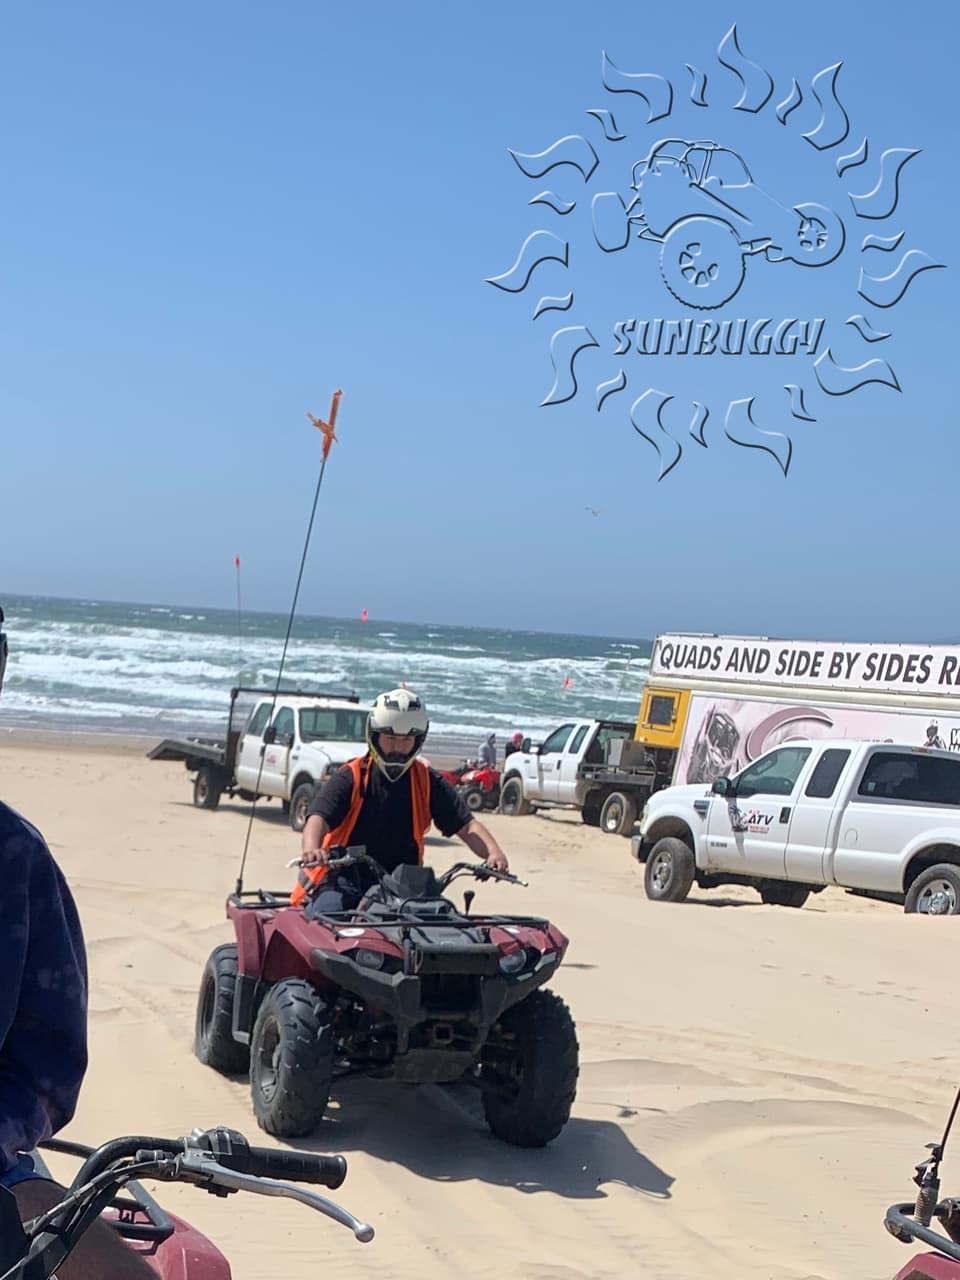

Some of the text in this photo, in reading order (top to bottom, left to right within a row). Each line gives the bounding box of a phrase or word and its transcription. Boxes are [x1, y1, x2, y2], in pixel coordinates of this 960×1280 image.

[659, 642, 723, 671] QUADS
[725, 646, 771, 675] AND
[775, 648, 825, 678] SIDE
[827, 650, 861, 680] BY
[862, 652, 934, 685] SIDES
[748, 814, 775, 826] ATV
